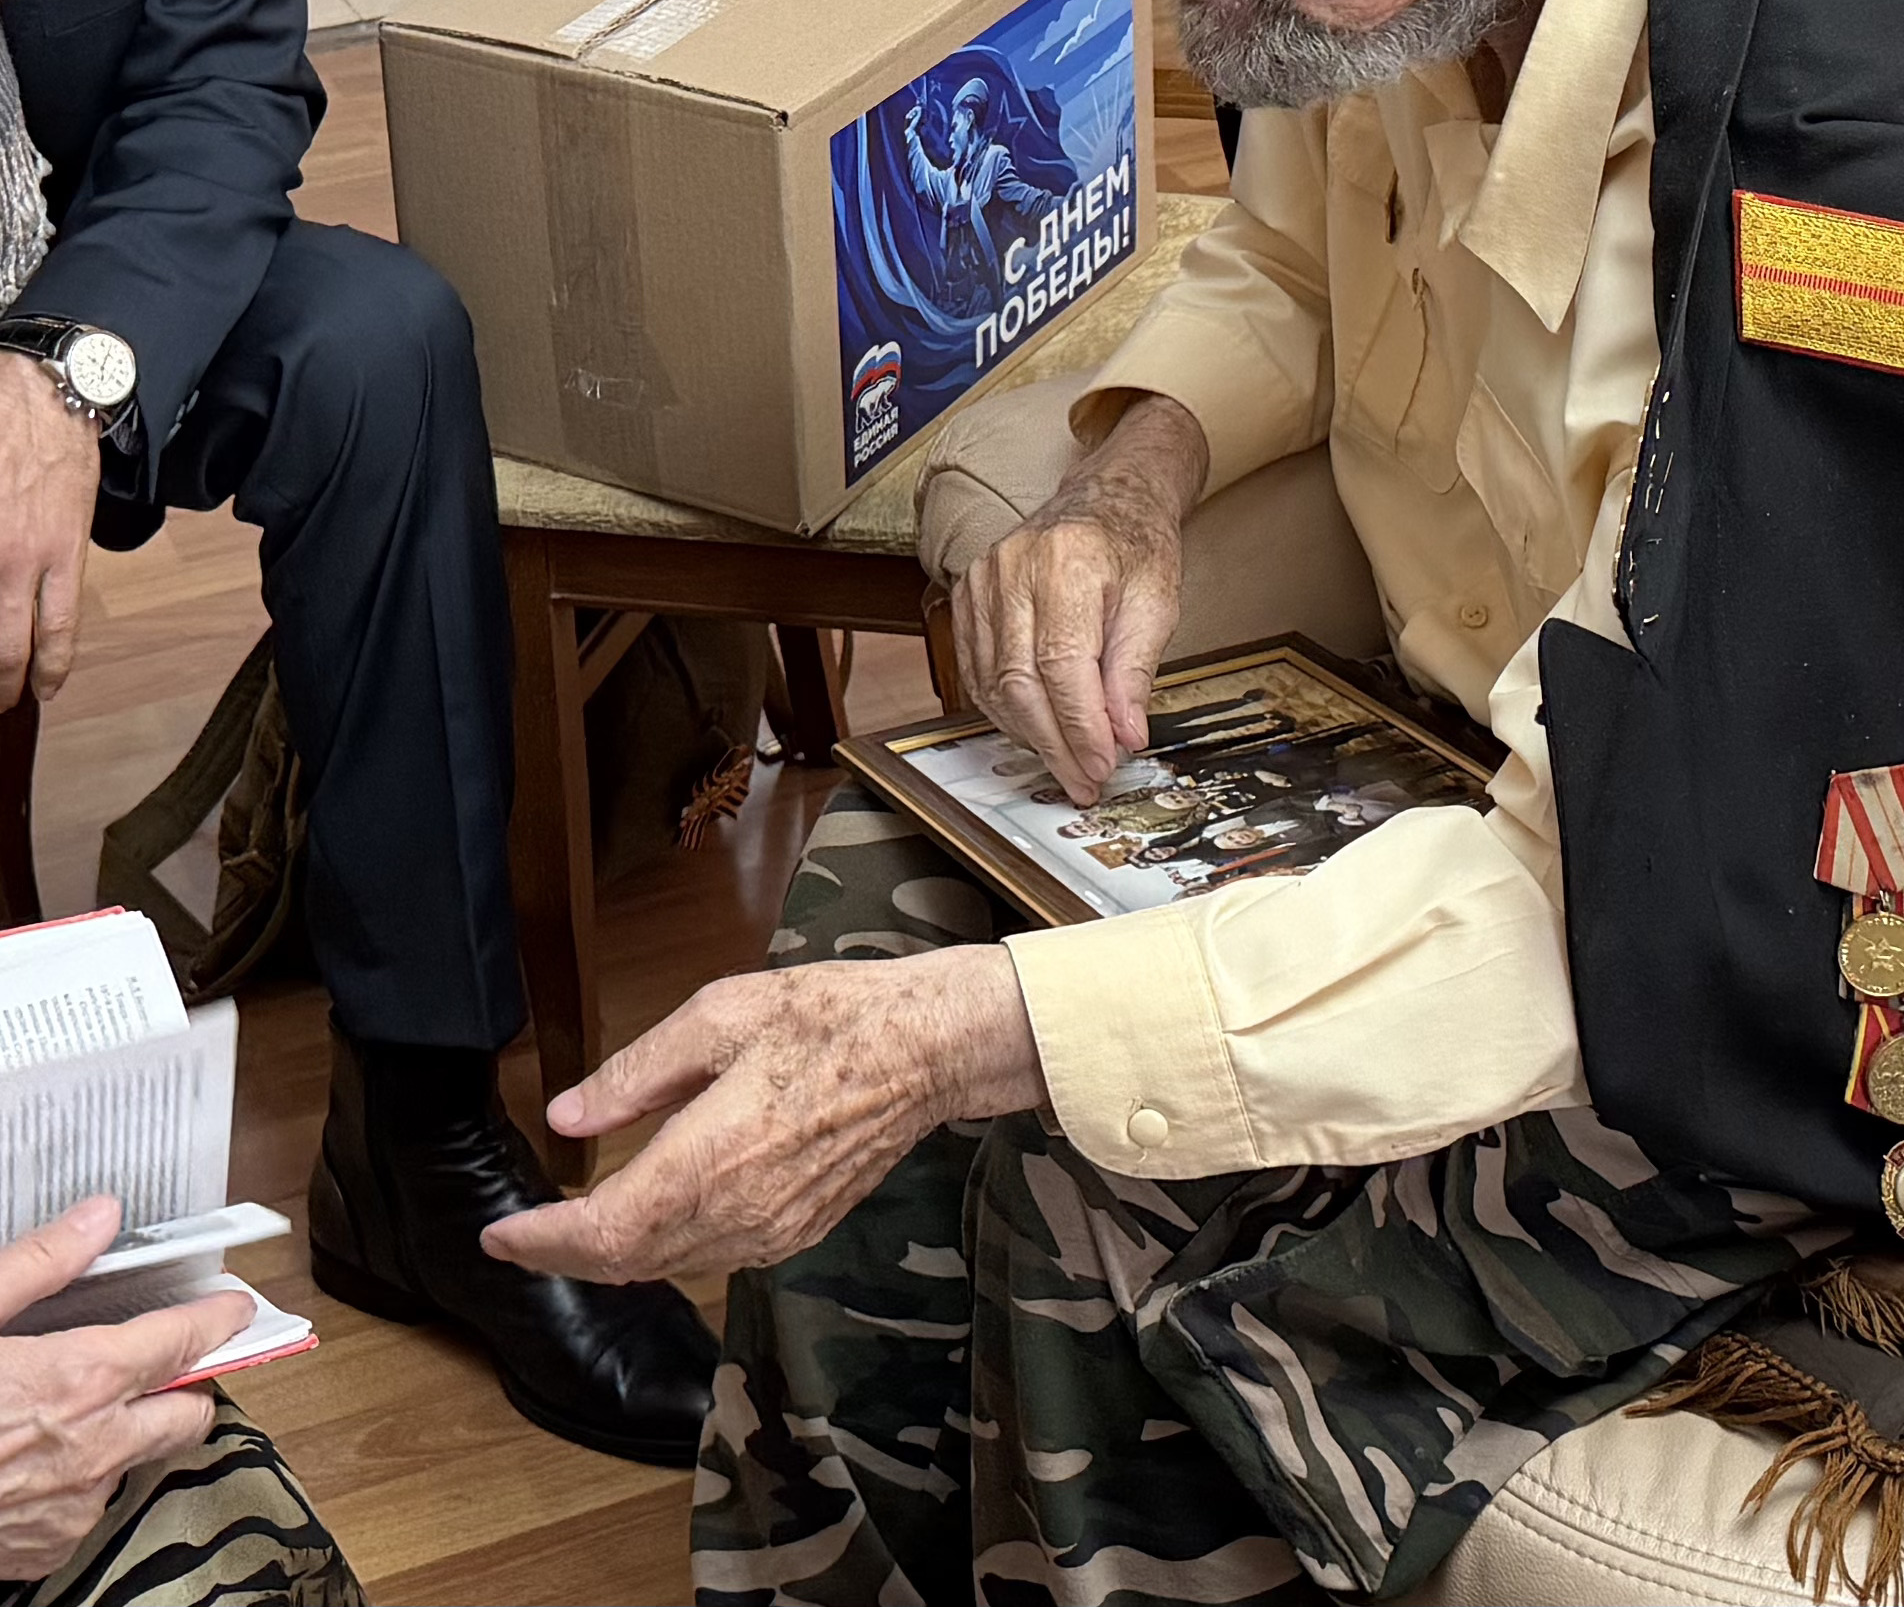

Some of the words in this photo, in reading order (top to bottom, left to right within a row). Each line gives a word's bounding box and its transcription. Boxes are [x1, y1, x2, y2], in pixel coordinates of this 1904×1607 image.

[1005, 236, 1026, 285] С
[1037, 154, 1129, 272] ДНЕМ
[976, 206, 1130, 369] ПОБЕДЫ!
[854, 406, 898, 452] ЕДИНАЯ
[854, 422, 898, 468] РОССИЯ
